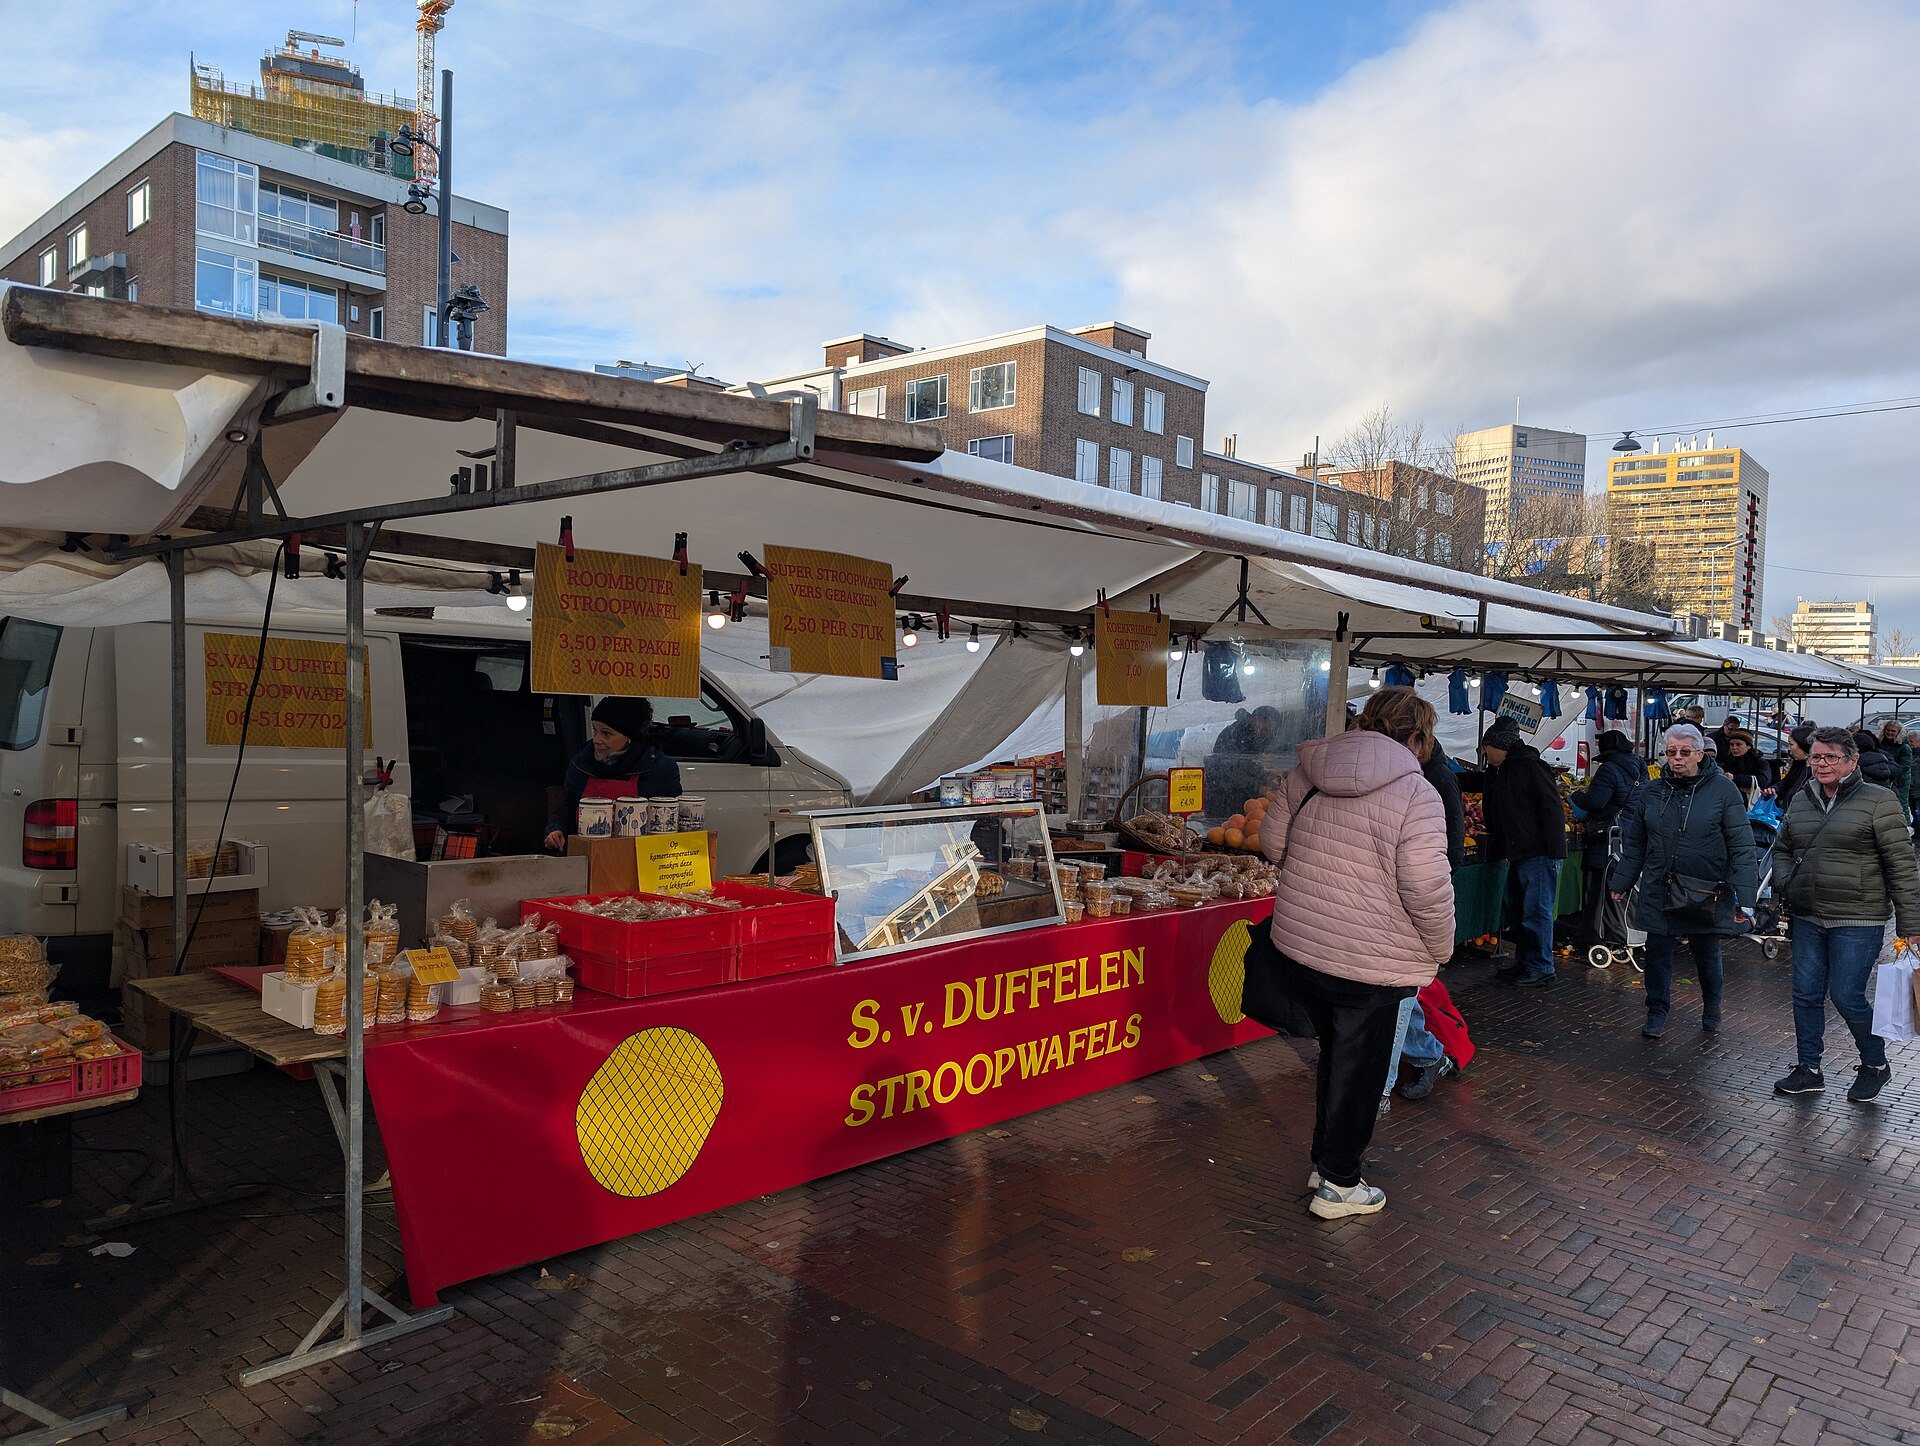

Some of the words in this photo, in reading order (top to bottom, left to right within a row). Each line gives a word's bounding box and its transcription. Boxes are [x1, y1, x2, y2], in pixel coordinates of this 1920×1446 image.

[566, 569, 675, 596] ROOMBOTER
[769, 562, 813, 579] SUPER
[816, 567, 890, 592] STROOPWAFEL
[559, 593, 681, 621] STROOPWAFEL
[788, 583, 822, 600] VERS
[825, 588, 877, 608] GEBAKKEN
[783, 614, 817, 635] 2,50
[821, 618, 848, 637] PER
[851, 622, 884, 641] STUK
[1105, 621, 1159, 637] KOEKKRUIMELS
[559, 633, 597, 654] 3,50
[601, 635, 635, 654] PER
[637, 638, 681, 657] PAKJE
[1113, 638, 1139, 651] GROTE
[1140, 640, 1153, 652] ZAK
[571, 658, 582, 675] 3
[586, 659, 637, 678] VOOR
[639, 662, 671, 682] 9,50
[1126, 664, 1142, 678] 1,00
[649, 849, 700, 861] kamertemperatuur
[669, 841, 679, 850] Op
[658, 861, 679, 870] smaken
[680, 860, 692, 868] deze
[658, 869, 694, 880] stroopwafels
[847, 999, 891, 1049] S.
[900, 1002, 933, 1037] v.
[942, 946, 1146, 1029] DUFFELEN
[844, 1013, 1143, 1128] STROOPWAFELS
